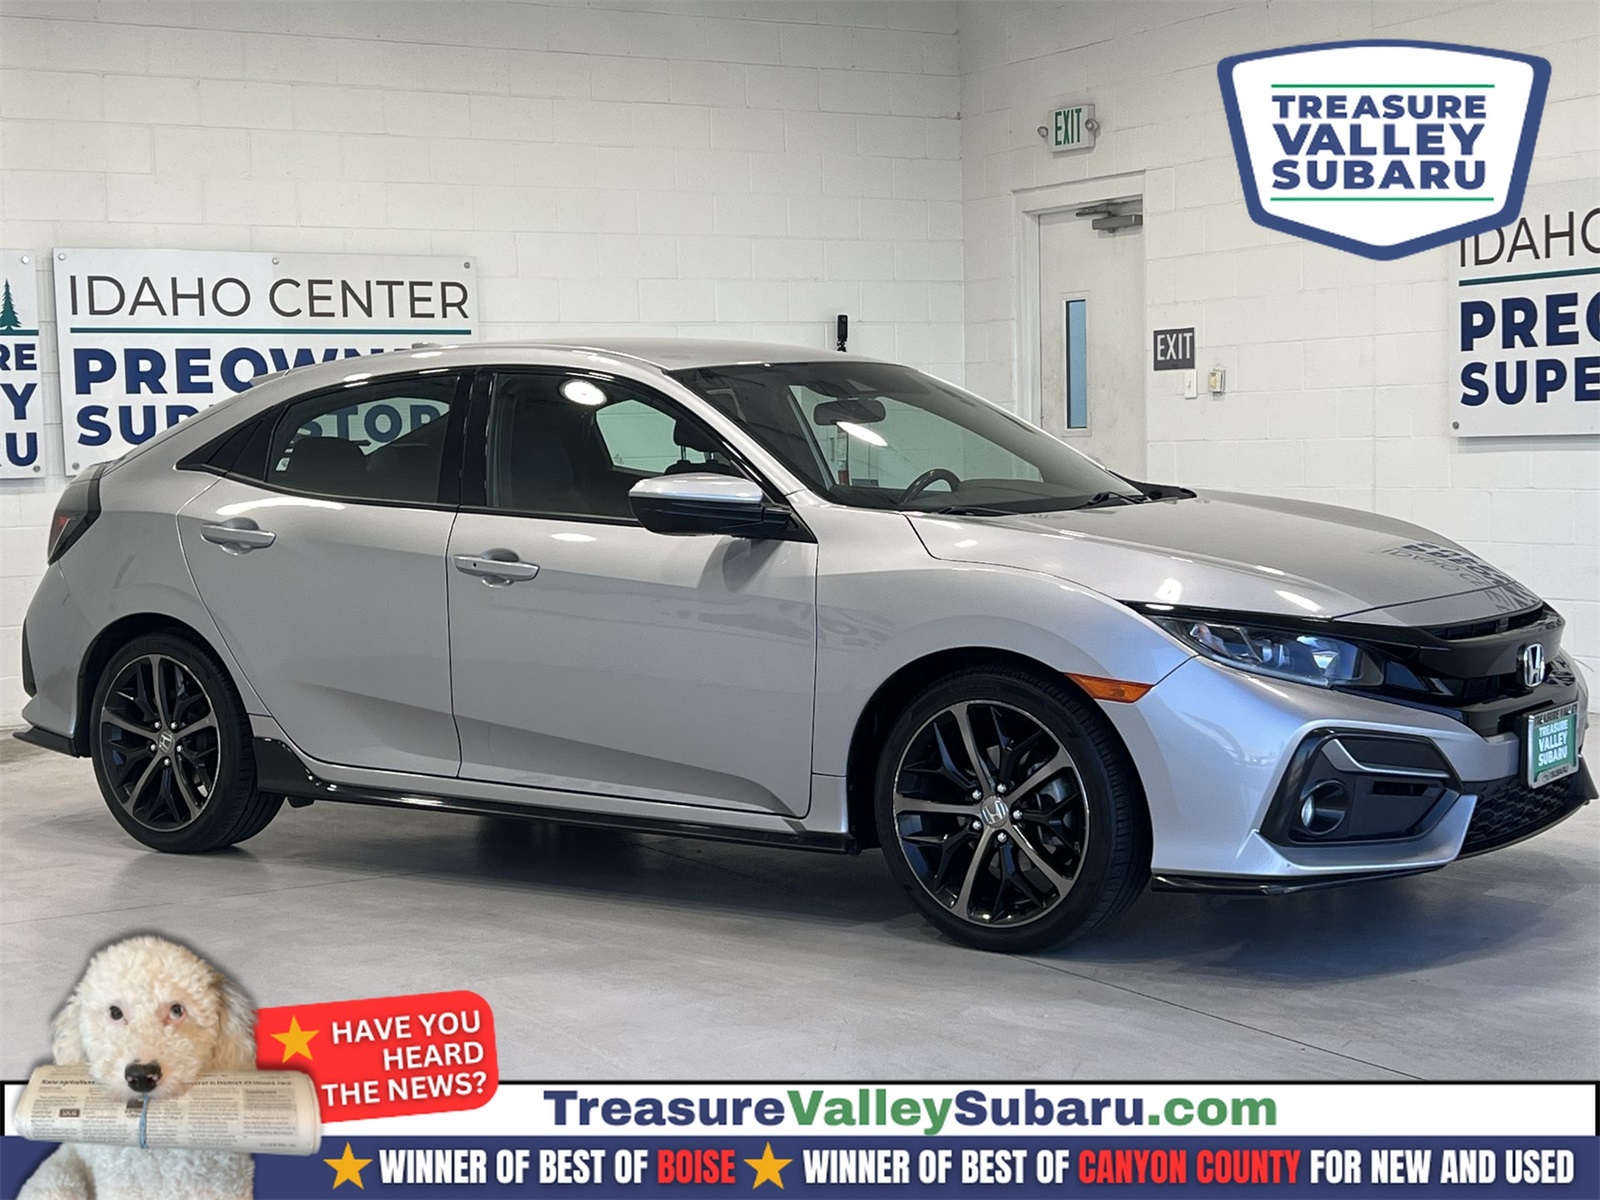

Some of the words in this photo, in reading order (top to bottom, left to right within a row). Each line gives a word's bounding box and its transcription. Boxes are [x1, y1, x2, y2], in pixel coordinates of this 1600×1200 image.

[1055, 107, 1082, 146] EXIT
[70, 275, 251, 317] IDAHO
[269, 278, 469, 319] CENTER
[1156, 332, 1193, 361] EXIT
[1539, 719, 1569, 737] TREASURE
[1539, 730, 1569, 752] VALLEY
[1538, 746, 1568, 767] SUBARU
